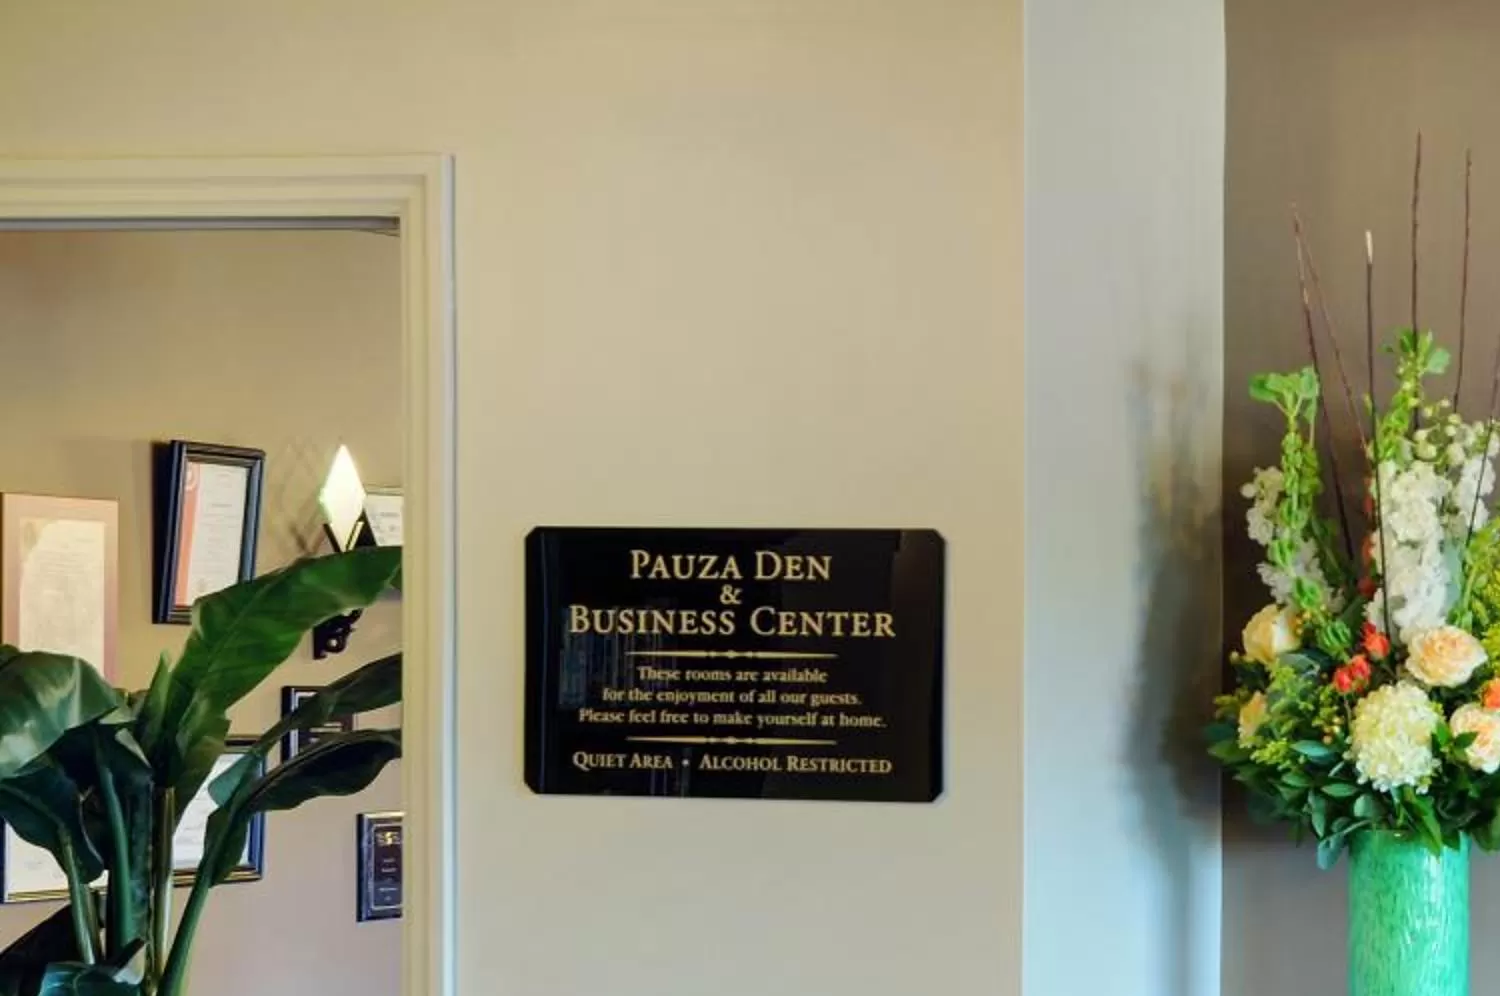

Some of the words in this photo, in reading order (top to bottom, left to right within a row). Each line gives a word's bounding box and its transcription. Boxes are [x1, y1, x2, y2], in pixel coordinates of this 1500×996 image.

[630, 550, 743, 580] PAUZA
[754, 551, 833, 581] DEN
[719, 583, 742, 606] &
[568, 604, 736, 635] BUSINESS
[750, 606, 897, 637] CENTER
[636, 665, 681, 681] These
[685, 668, 731, 682] rooms
[735, 670, 759, 682] are
[762, 668, 829, 683] available
[602, 687, 625, 701] for
[628, 687, 653, 701] the
[656, 688, 735, 707] enjoyment
[738, 689, 757, 703] of
[757, 689, 777, 704] all
[779, 692, 807, 704] our
[810, 692, 862, 708] guests.
[578, 707, 625, 723] Please
[628, 708, 656, 723] feel
[659, 709, 689, 724] free
[693, 712, 709, 724] to
[712, 710, 753, 725] make
[757, 711, 818, 730] yourself
[820, 714, 836, 727] at
[839, 712, 888, 728] home.
[572, 751, 627, 772] QUIET
[629, 752, 673, 769] AREA
[698, 753, 782, 771] ALCOHOL
[787, 755, 892, 774] RESTRICTED
